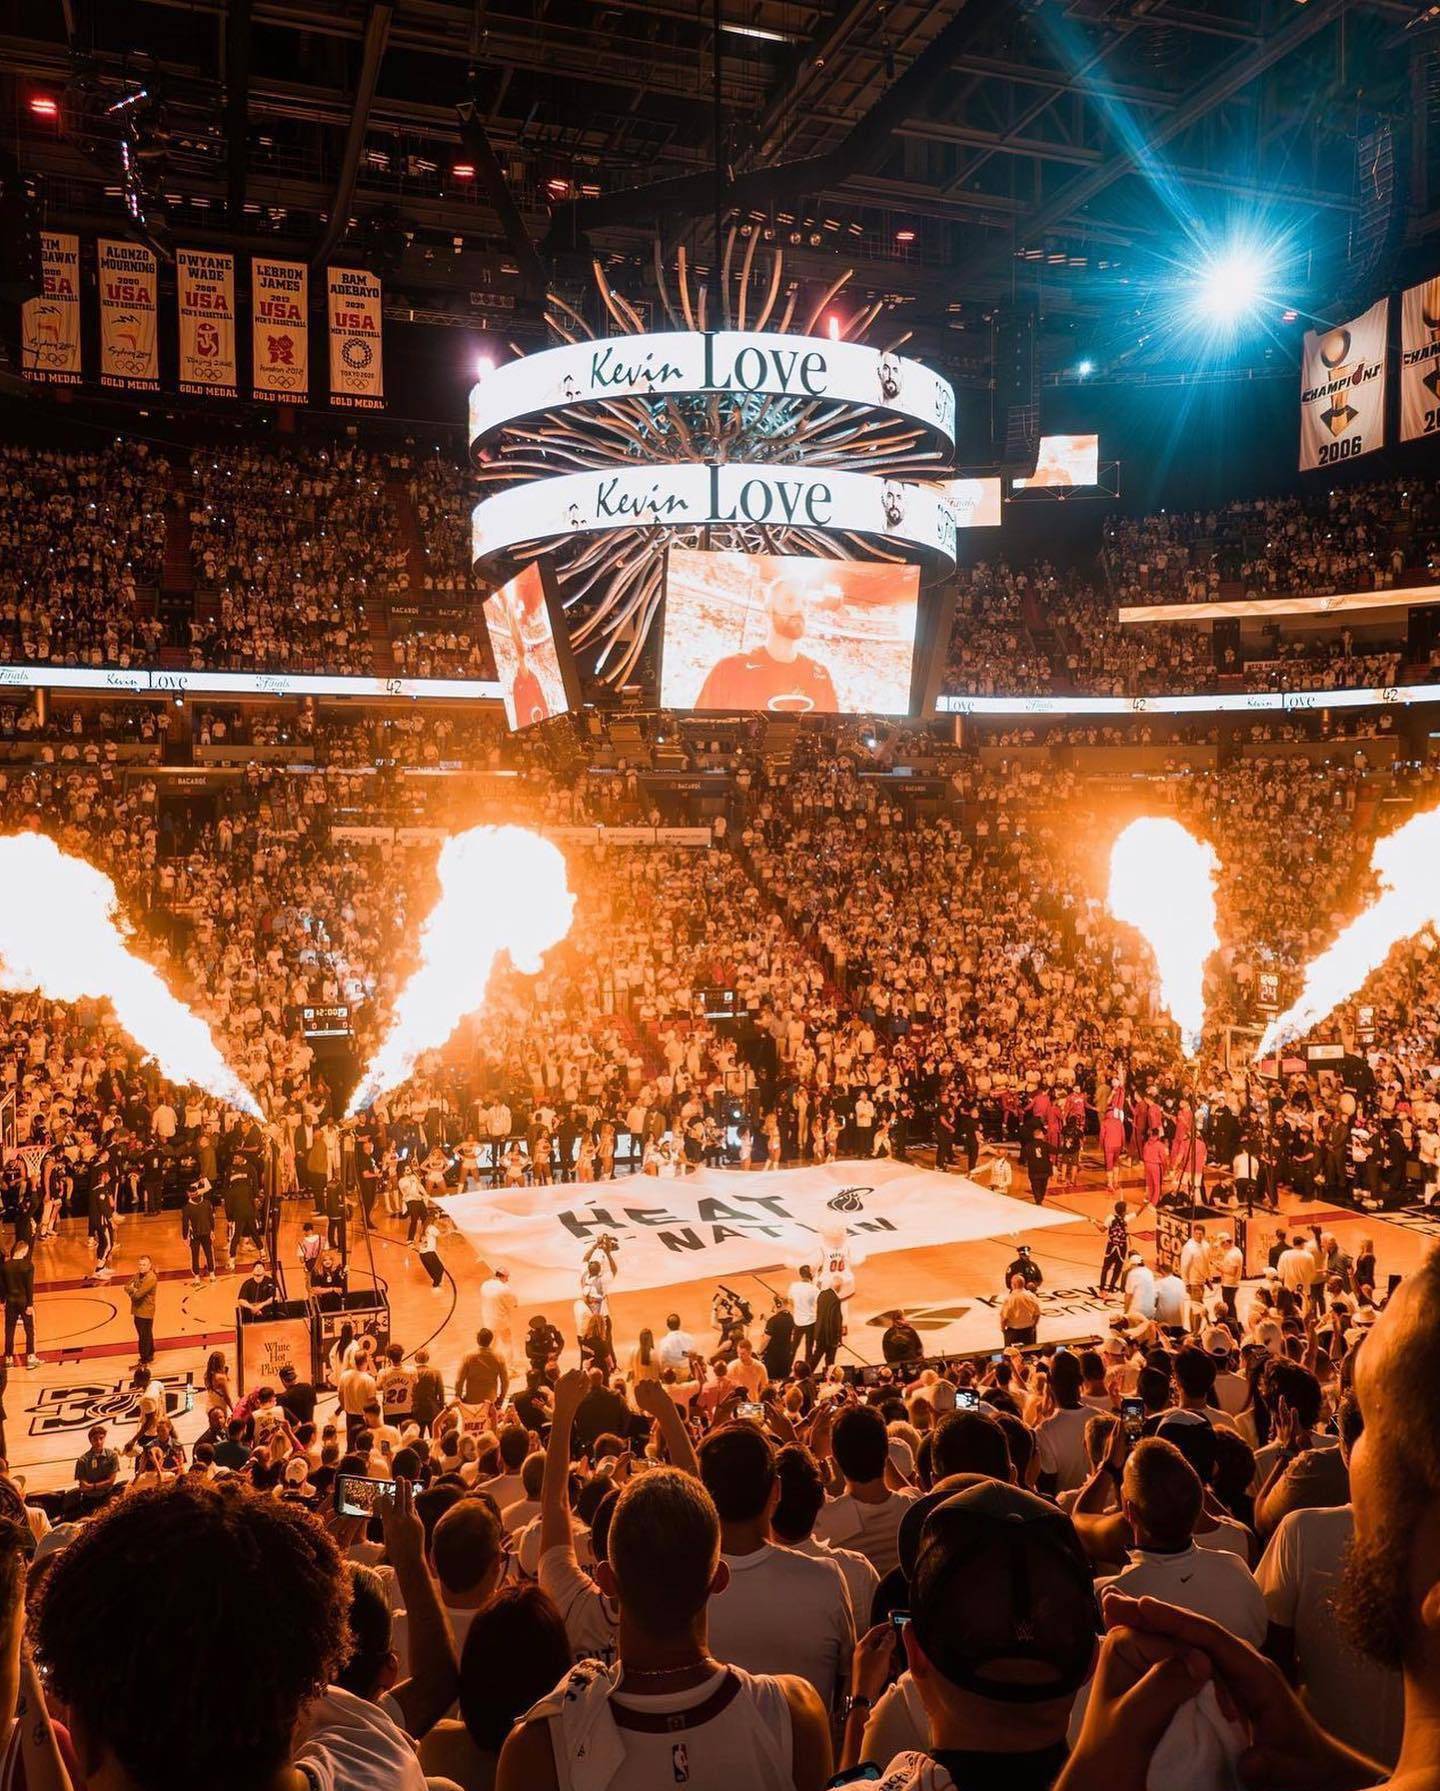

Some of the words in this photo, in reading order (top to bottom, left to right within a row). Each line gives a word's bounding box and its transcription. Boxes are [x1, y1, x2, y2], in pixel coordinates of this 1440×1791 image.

[106, 246, 149, 261] ALONZO
[101, 258, 155, 273] MOURNING
[178, 254, 232, 270] DWYANE
[188, 267, 224, 281] WADE
[256, 265, 303, 280] LEBRON
[341, 273, 367, 286] BAM
[43, 277, 73, 294] SA
[260, 277, 300, 292] JAMES
[330, 284, 380, 298] ADEBAYO
[106, 284, 151, 303] USA
[270, 295, 290, 303] 2012
[185, 291, 229, 311] USA
[259, 301, 302, 320] USA
[335, 312, 375, 330] USA
[591, 347, 684, 389] Kevin
[700, 331, 828, 396] Love
[48, 373, 83, 384] MEDAL
[101, 376, 125, 388] GOLD
[128, 380, 160, 391] MEDAL
[180, 384, 203, 395] GOLD
[205, 386, 238, 398] MEDAL
[253, 391, 276, 401] GOLD
[277, 393, 309, 404] MEDAL
[330, 396, 352, 406] GOLD
[354, 398, 385, 409] MEDAL
[1319, 435, 1362, 465] 2006
[596, 477, 689, 518] Kevin
[704, 463, 832, 527] Love
[106, 673, 138, 686] Kevin
[386, 680, 402, 694] 42
[1382, 688, 1398, 701] 42
[1132, 699, 1146, 711] 42
[311, 1022, 317, 1030] 0
[343, 1021, 348, 1029] 0
[557, 1195, 796, 1239] HEAT
[829, 1260, 845, 1272] 00
[264, 1342, 290, 1352] White
[270, 1352, 286, 1362] Hot
